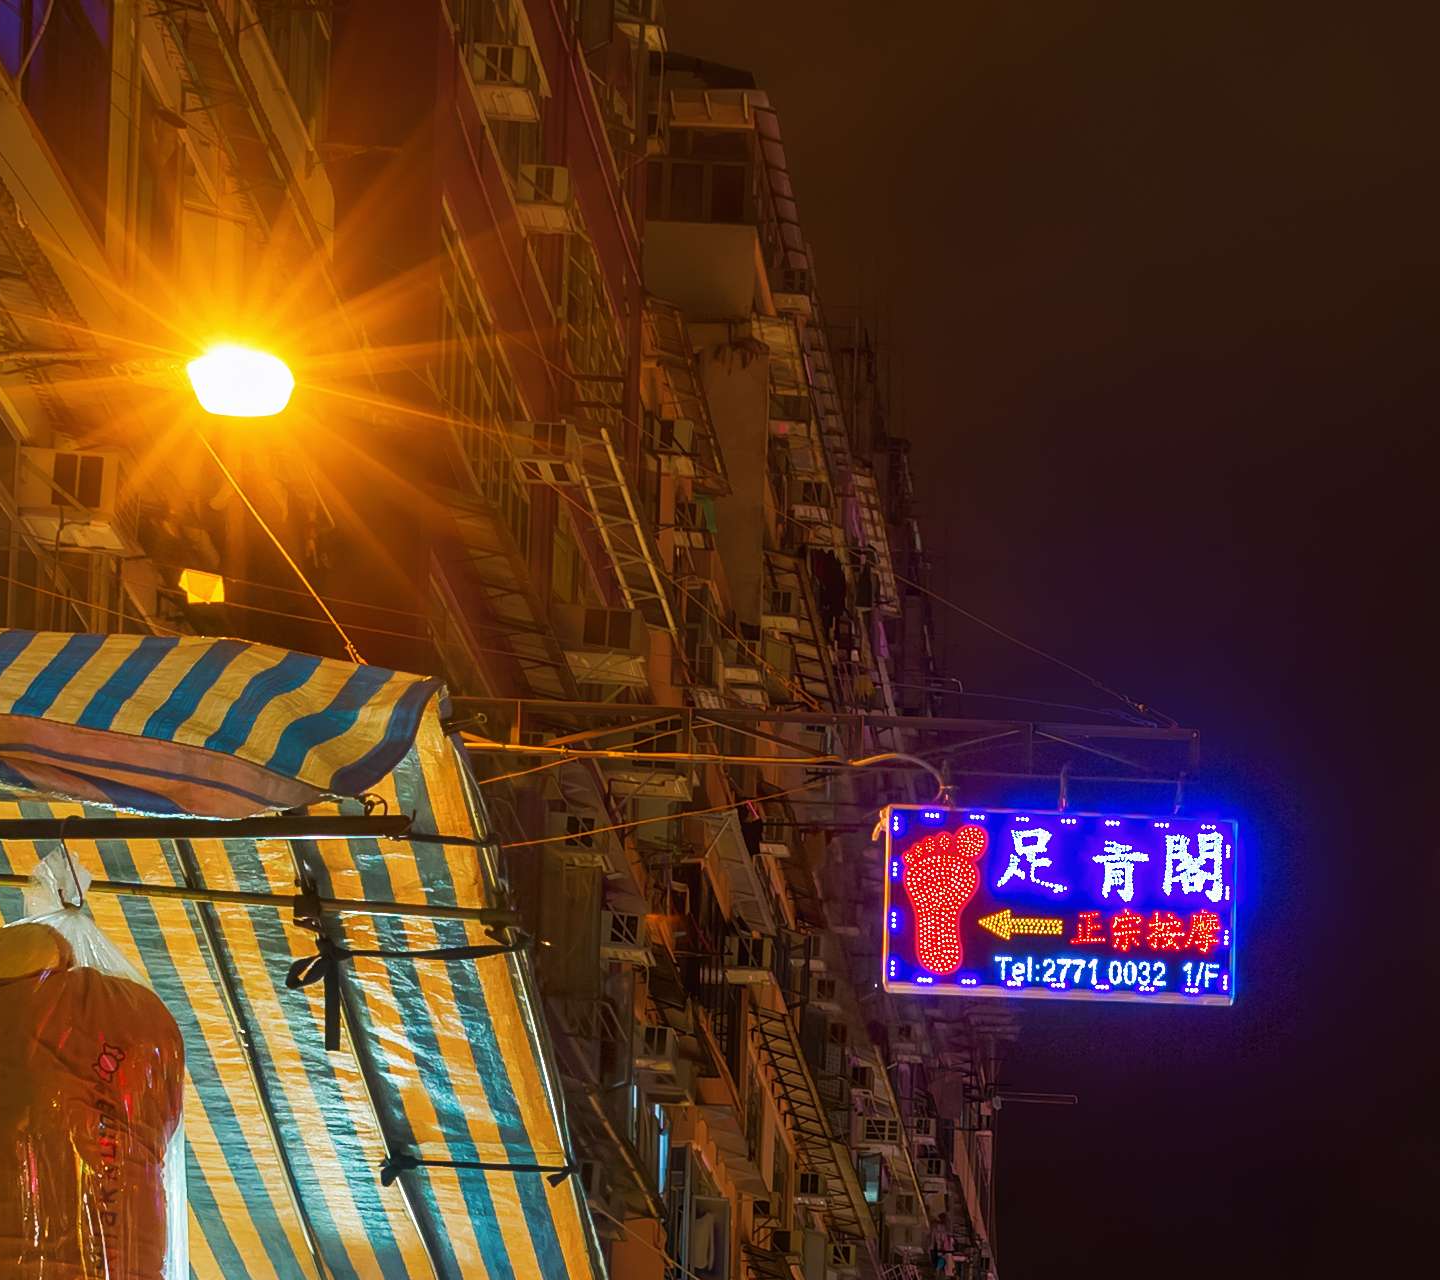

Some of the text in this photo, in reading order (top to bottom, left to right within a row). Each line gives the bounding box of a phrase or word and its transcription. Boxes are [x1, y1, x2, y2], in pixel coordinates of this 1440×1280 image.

[1070, 909, 1220, 952] 正宗按摩
[1182, 962, 1220, 987] 1/F
